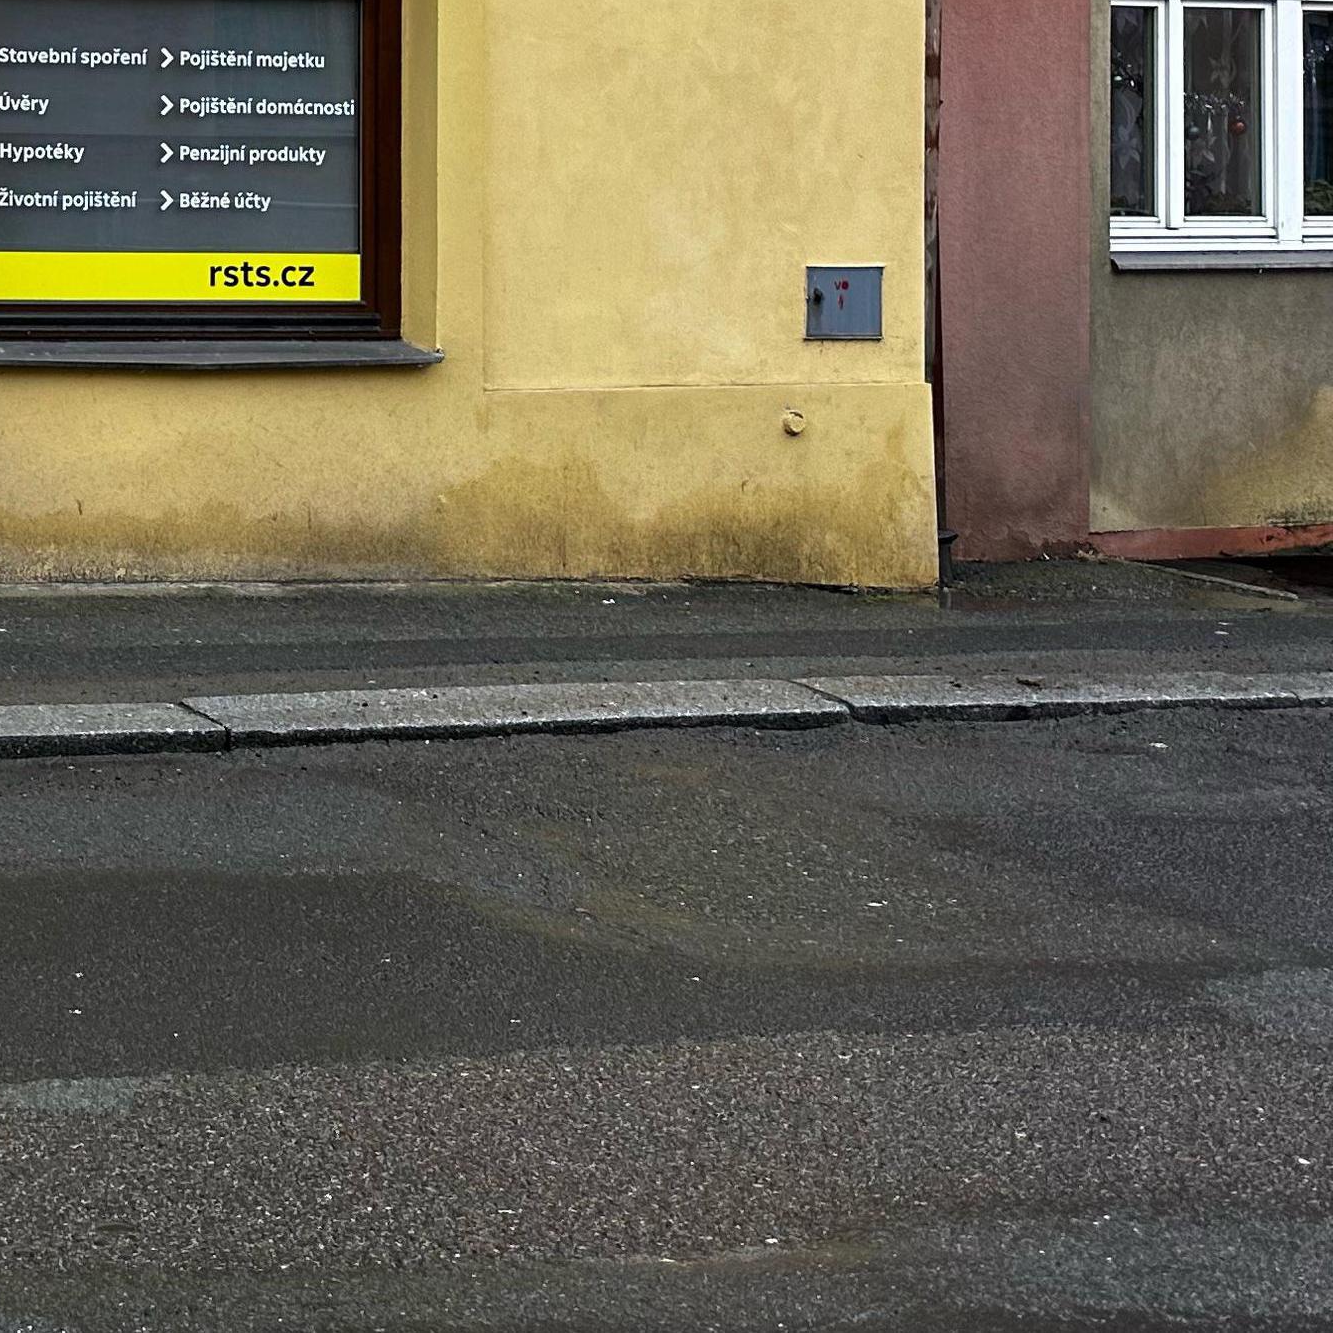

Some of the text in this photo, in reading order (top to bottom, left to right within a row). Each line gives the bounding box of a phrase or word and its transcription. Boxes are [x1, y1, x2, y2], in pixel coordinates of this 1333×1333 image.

[80, 48, 148, 67] spoření
[179, 49, 325, 71] Pojištění majetku
[0, 91, 50, 115] Úvěry
[179, 97, 355, 118] Pojištění domácnosti
[0, 141, 85, 164] Hypotéky
[179, 144, 326, 166] Penzijní produkty
[62, 190, 137, 212] pojištění
[179, 191, 272, 212] Běžné účty
[209, 261, 316, 288] rsts.cz
